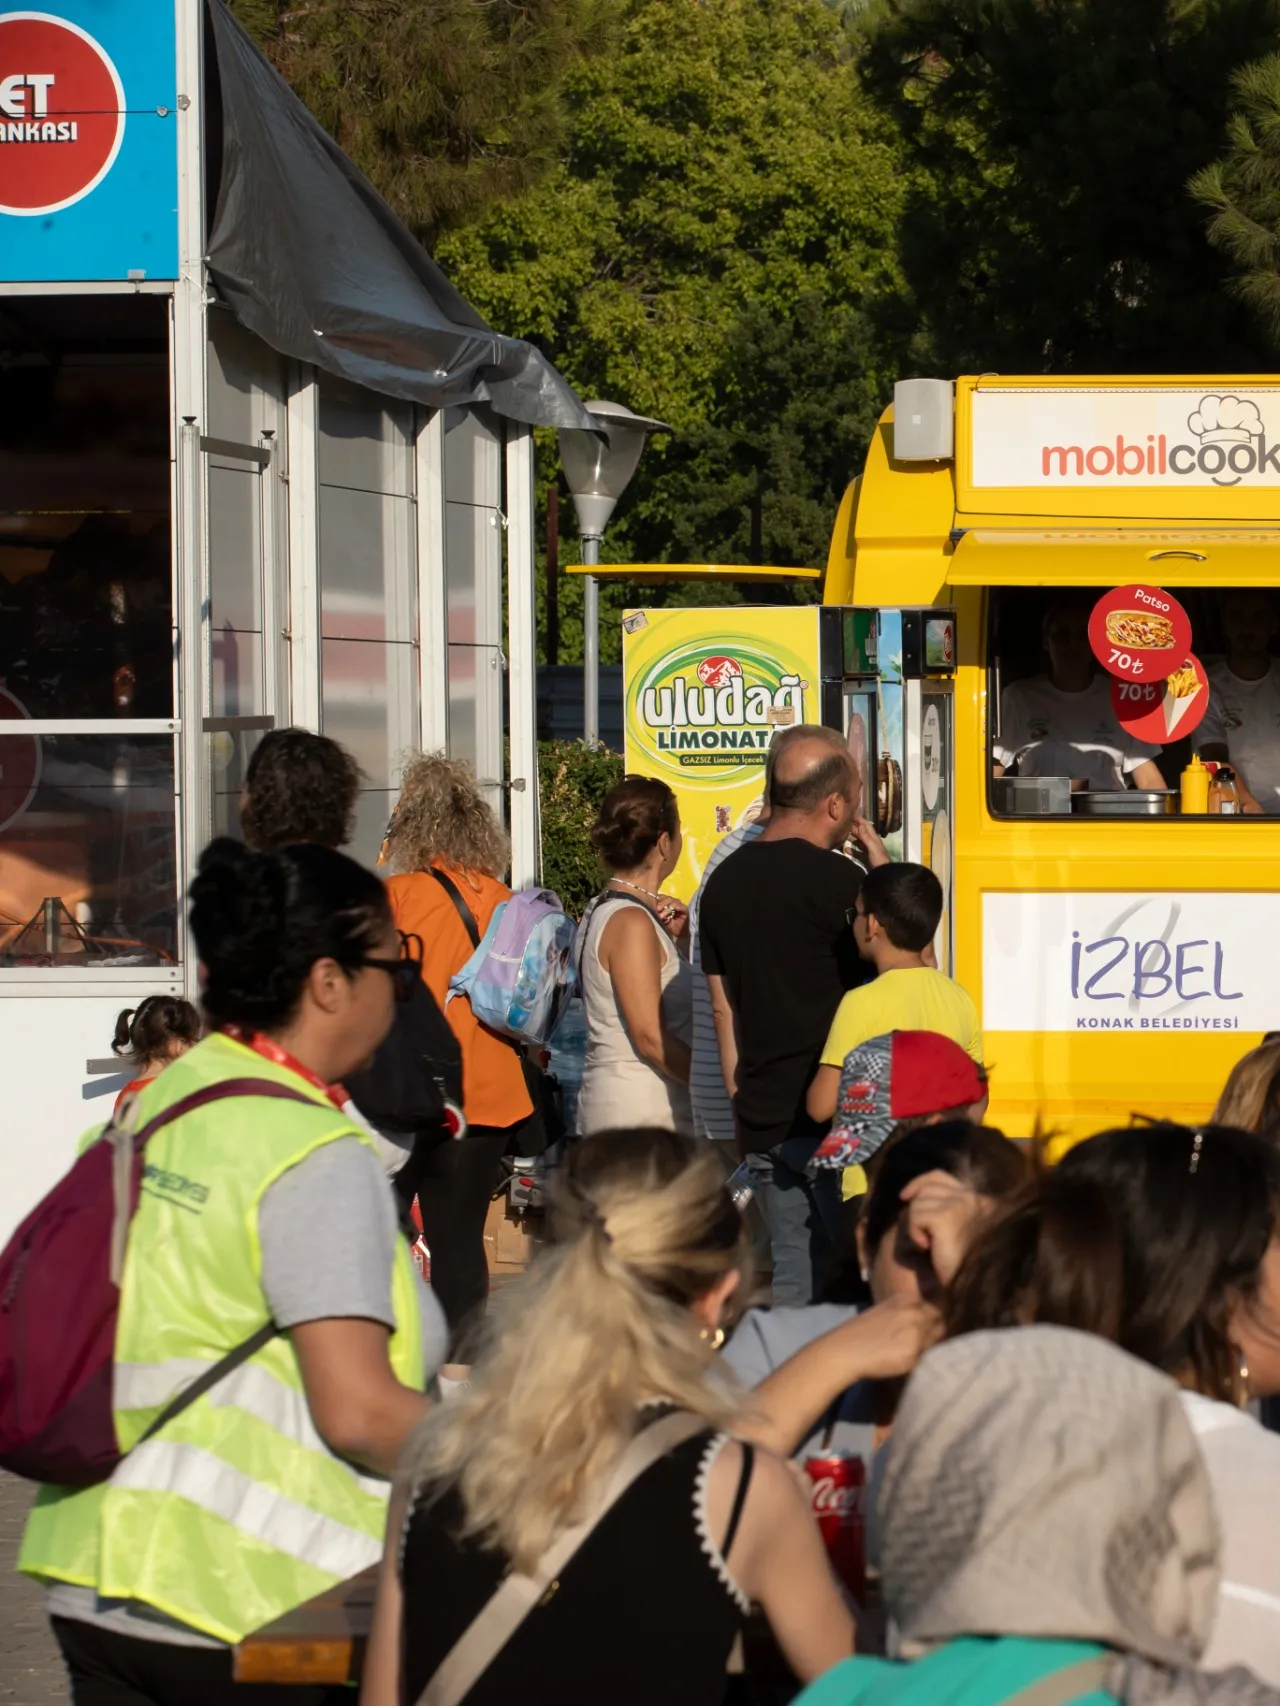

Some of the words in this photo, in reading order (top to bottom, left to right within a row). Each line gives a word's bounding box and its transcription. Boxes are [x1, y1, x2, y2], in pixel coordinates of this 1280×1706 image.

[1134, 588, 1171, 613] Patso
[657, 724, 778, 750] LİMONAT
[682, 755, 712, 765] GAZSIZ
[713, 755, 740, 765] Limonlu
[741, 753, 765, 766] İçecek
[1070, 930, 1244, 1001] İZBEL
[1076, 1017, 1135, 1029] KONAK
[1140, 1015, 1240, 1029] BELEDİYESİ
